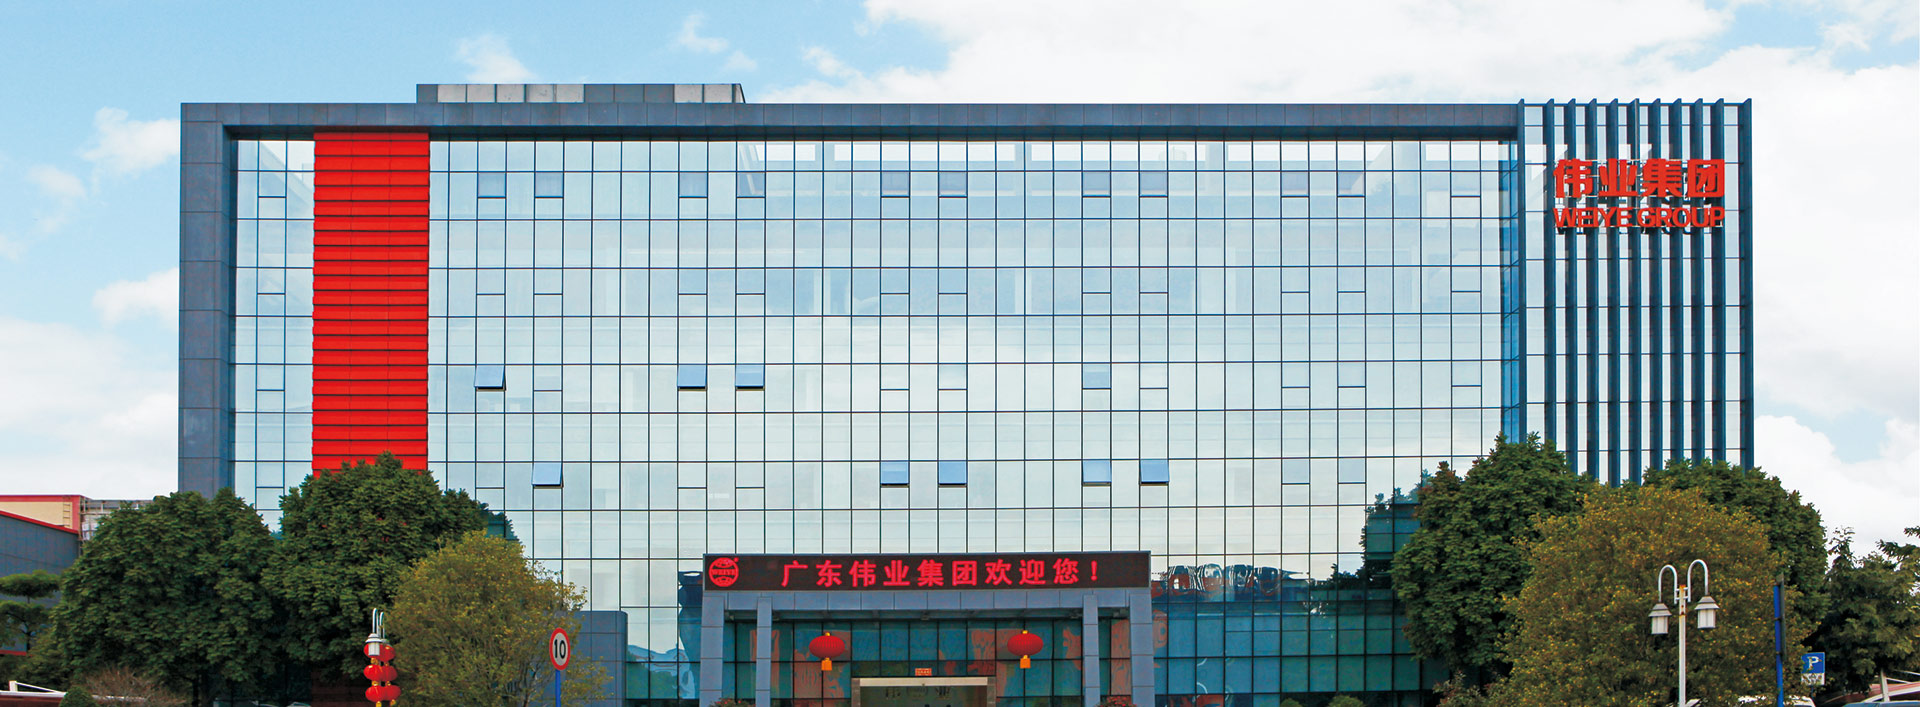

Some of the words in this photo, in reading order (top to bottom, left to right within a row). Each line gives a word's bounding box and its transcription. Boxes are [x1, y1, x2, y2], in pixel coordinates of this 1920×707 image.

[1553, 158, 1725, 198] 伟业集团
[1553, 206, 1633, 228] WEIYE
[1637, 206, 1725, 228] GROUP
[554, 639, 566, 659] 10
[1807, 655, 1819, 670] P
